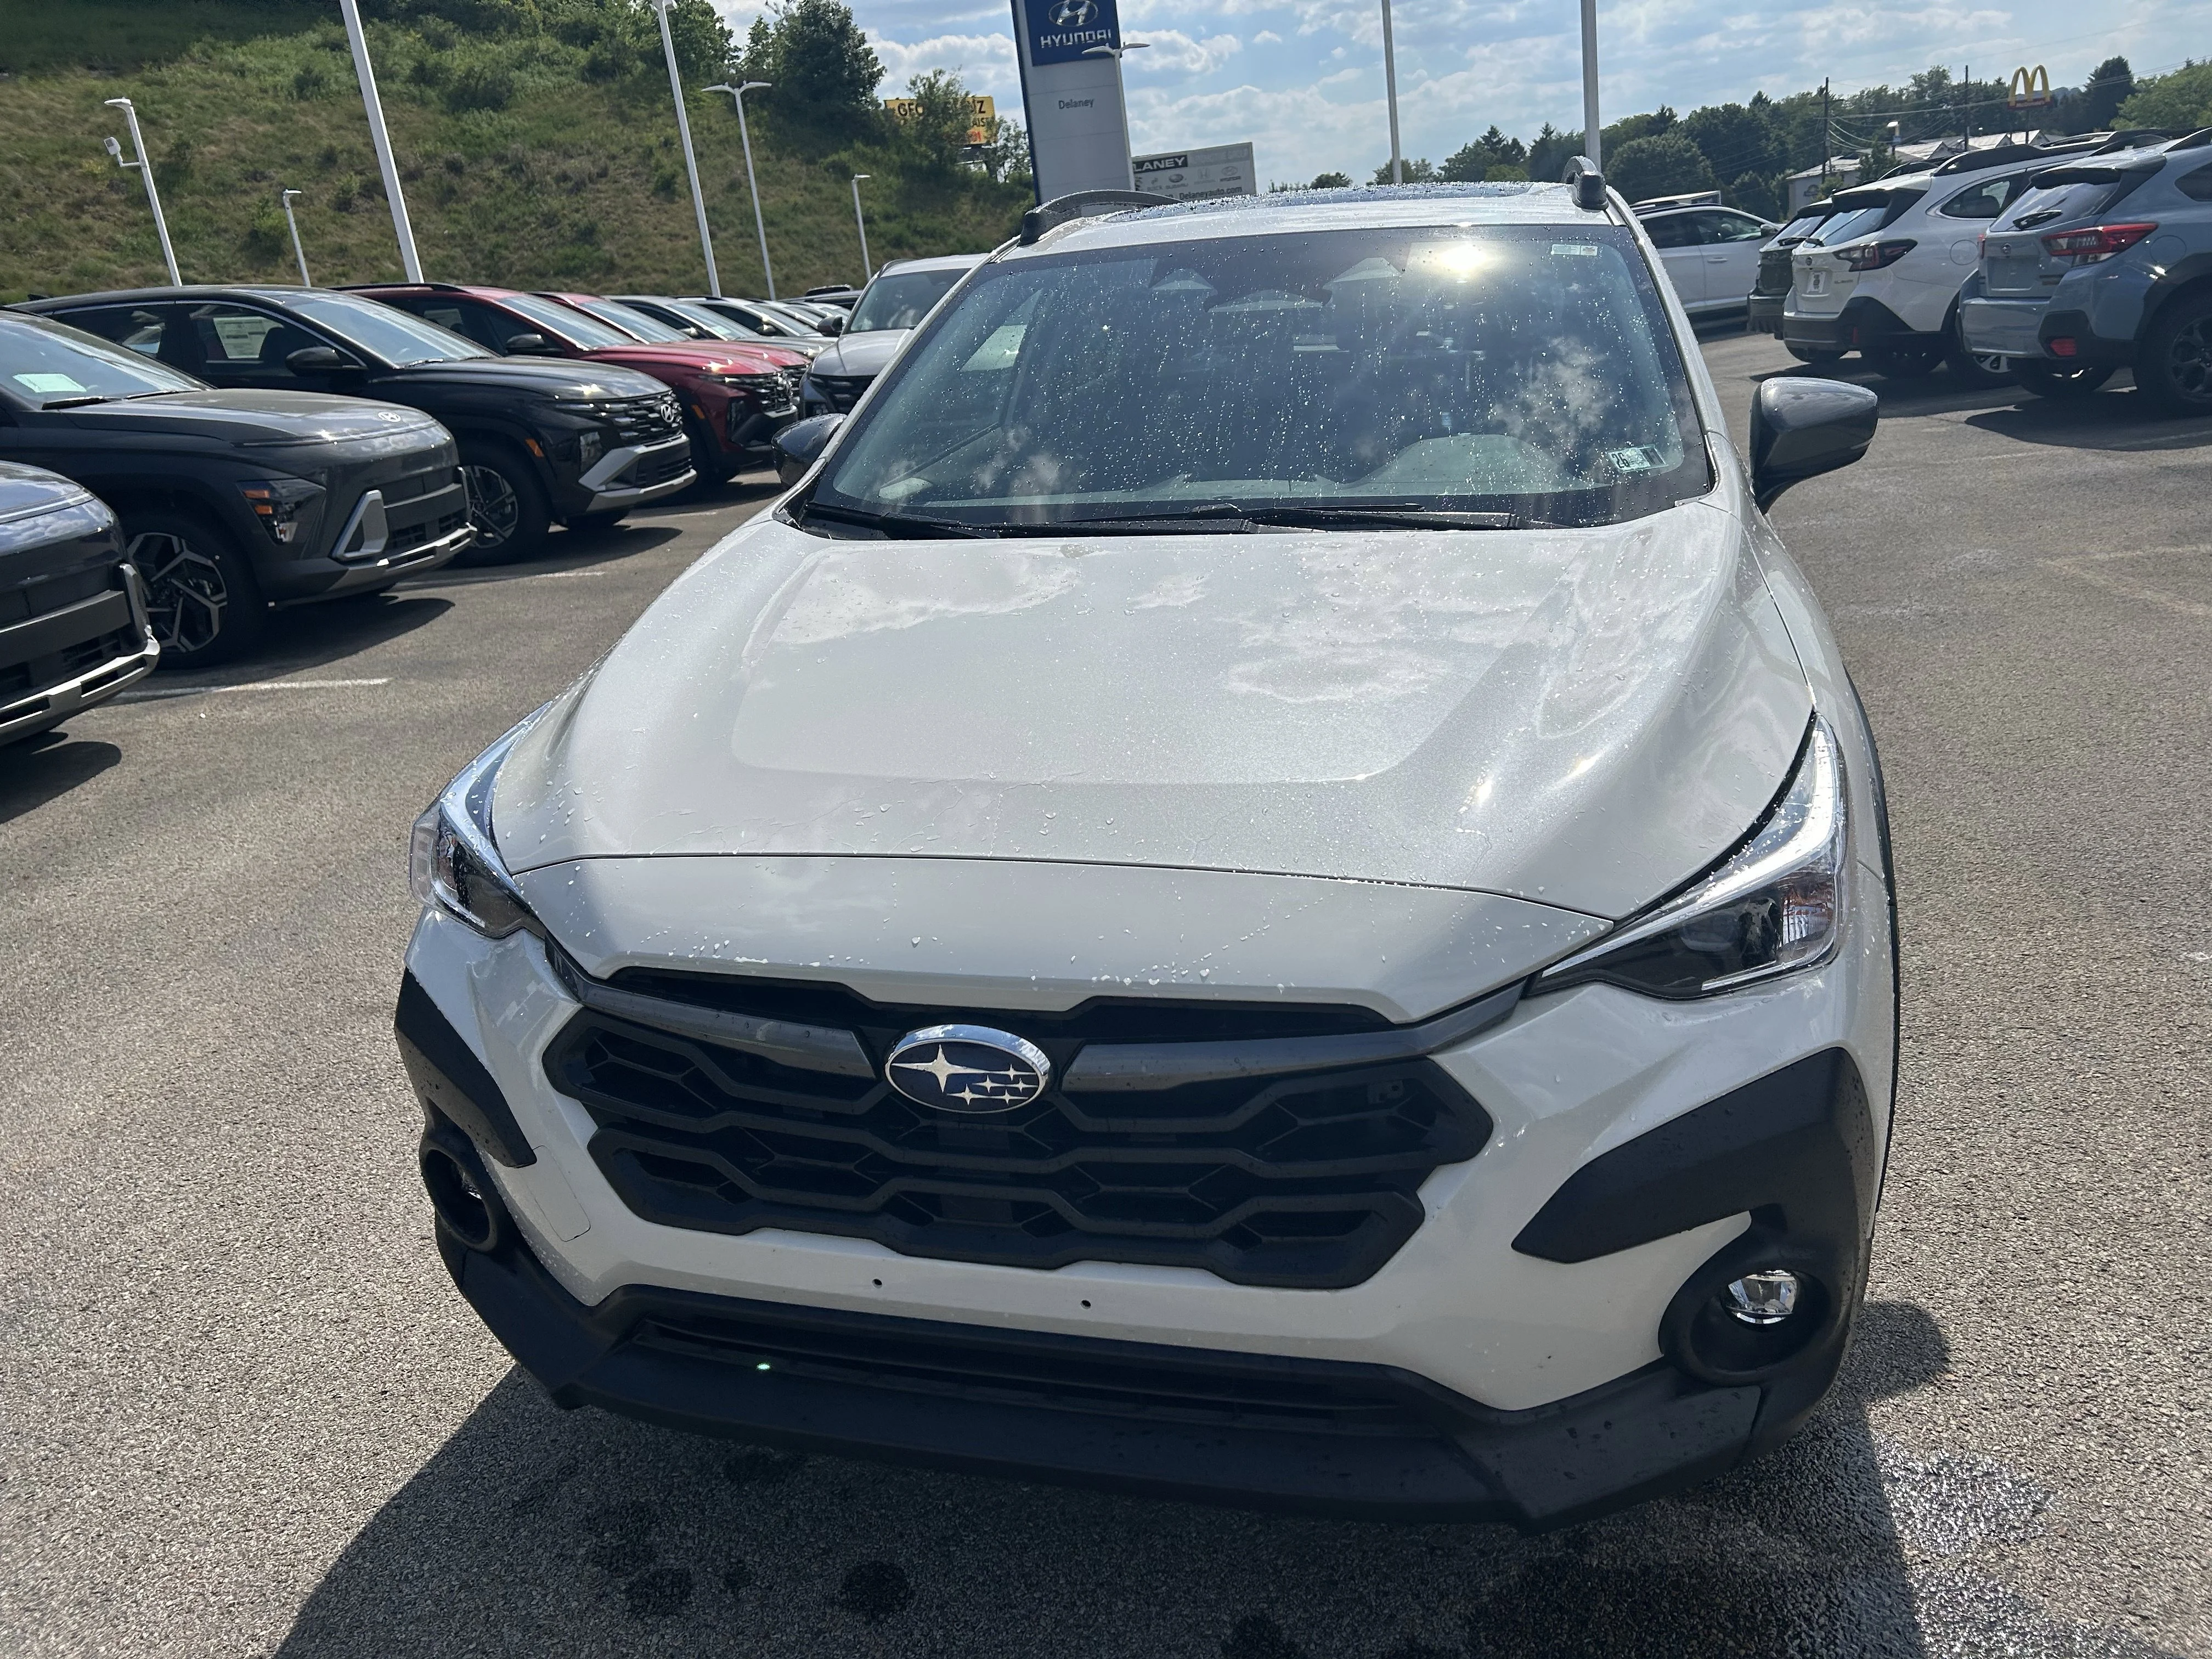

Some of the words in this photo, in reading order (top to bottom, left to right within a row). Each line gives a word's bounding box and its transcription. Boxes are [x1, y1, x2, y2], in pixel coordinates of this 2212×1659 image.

[1040, 29, 1111, 48] HYUNDAI
[1058, 99, 1094, 110] Delaney
[1611, 452, 1630, 469] 26
